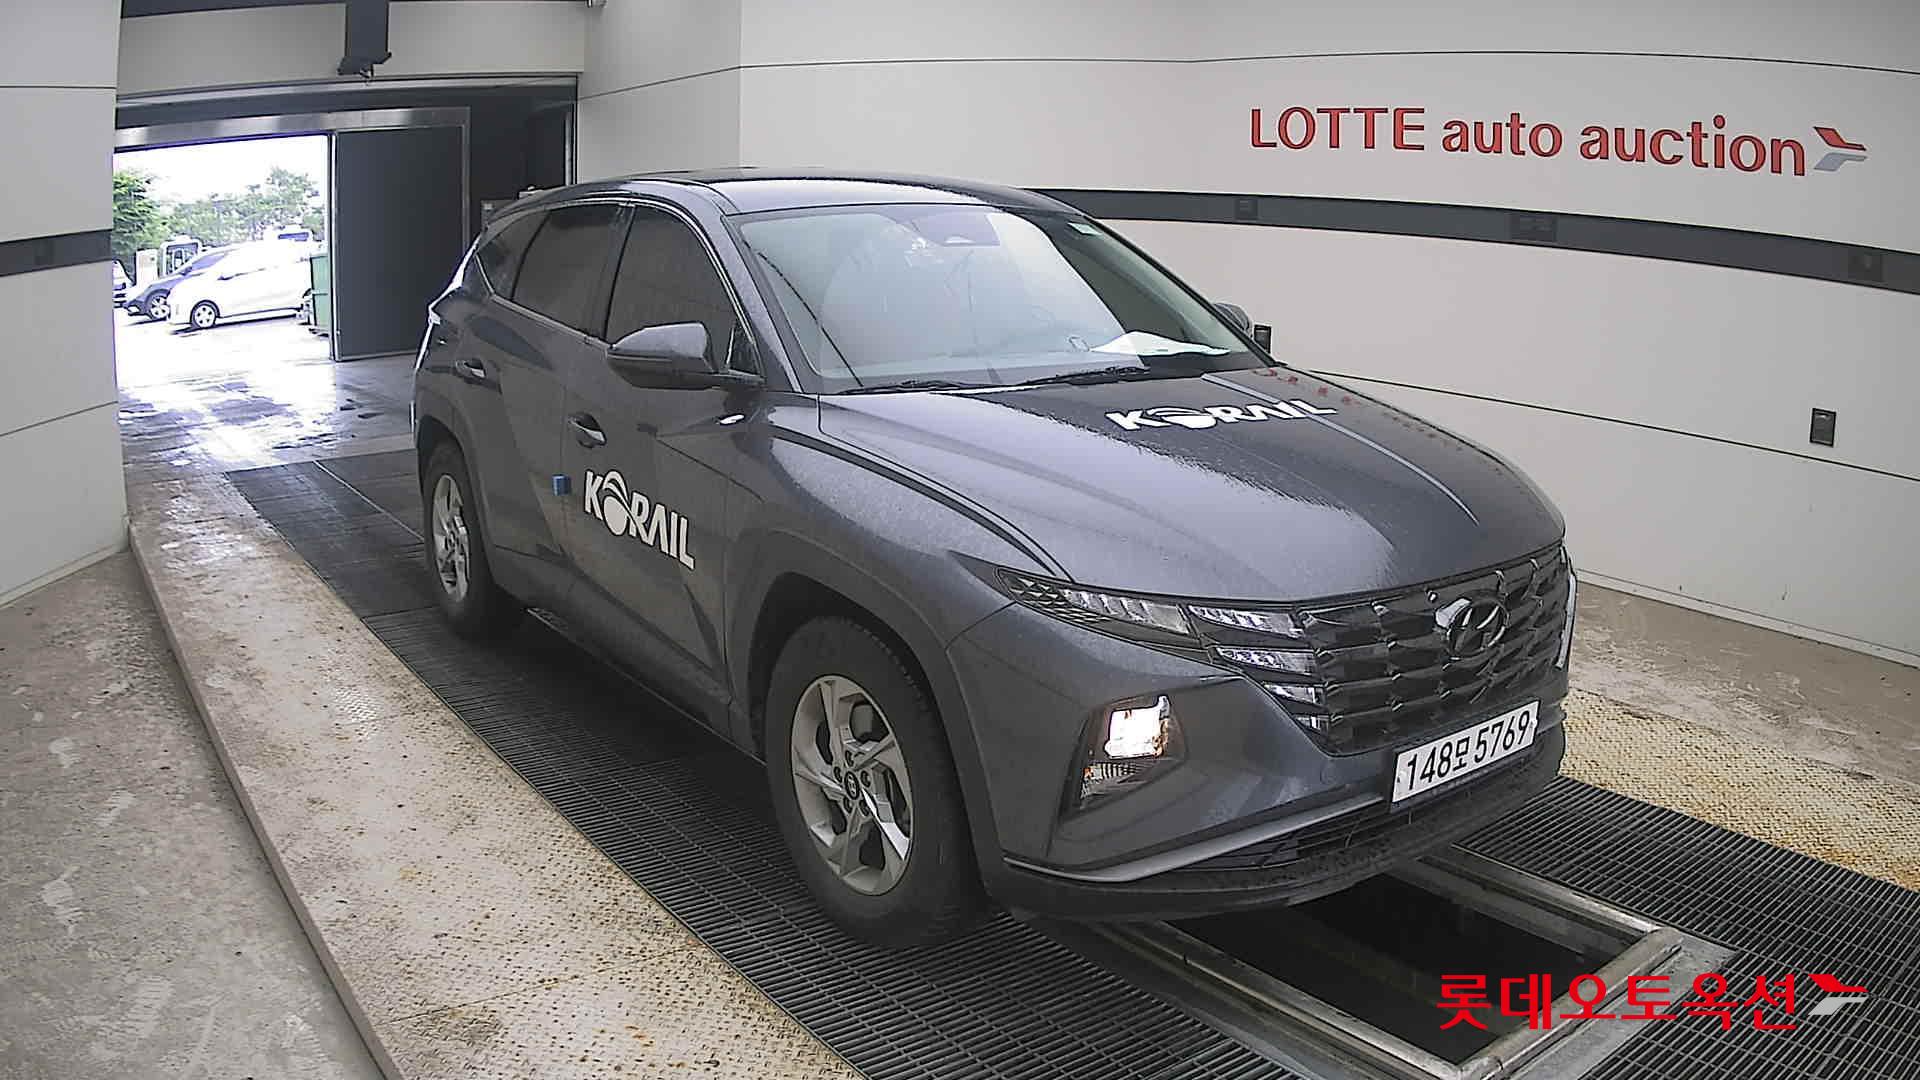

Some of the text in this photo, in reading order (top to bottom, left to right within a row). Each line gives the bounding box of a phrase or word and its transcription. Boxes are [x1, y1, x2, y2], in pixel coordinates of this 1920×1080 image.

[1251, 107, 1806, 176] LOTTE auto auction
[1105, 400, 1337, 431] KORAIL
[585, 469, 695, 570] KORAIL
